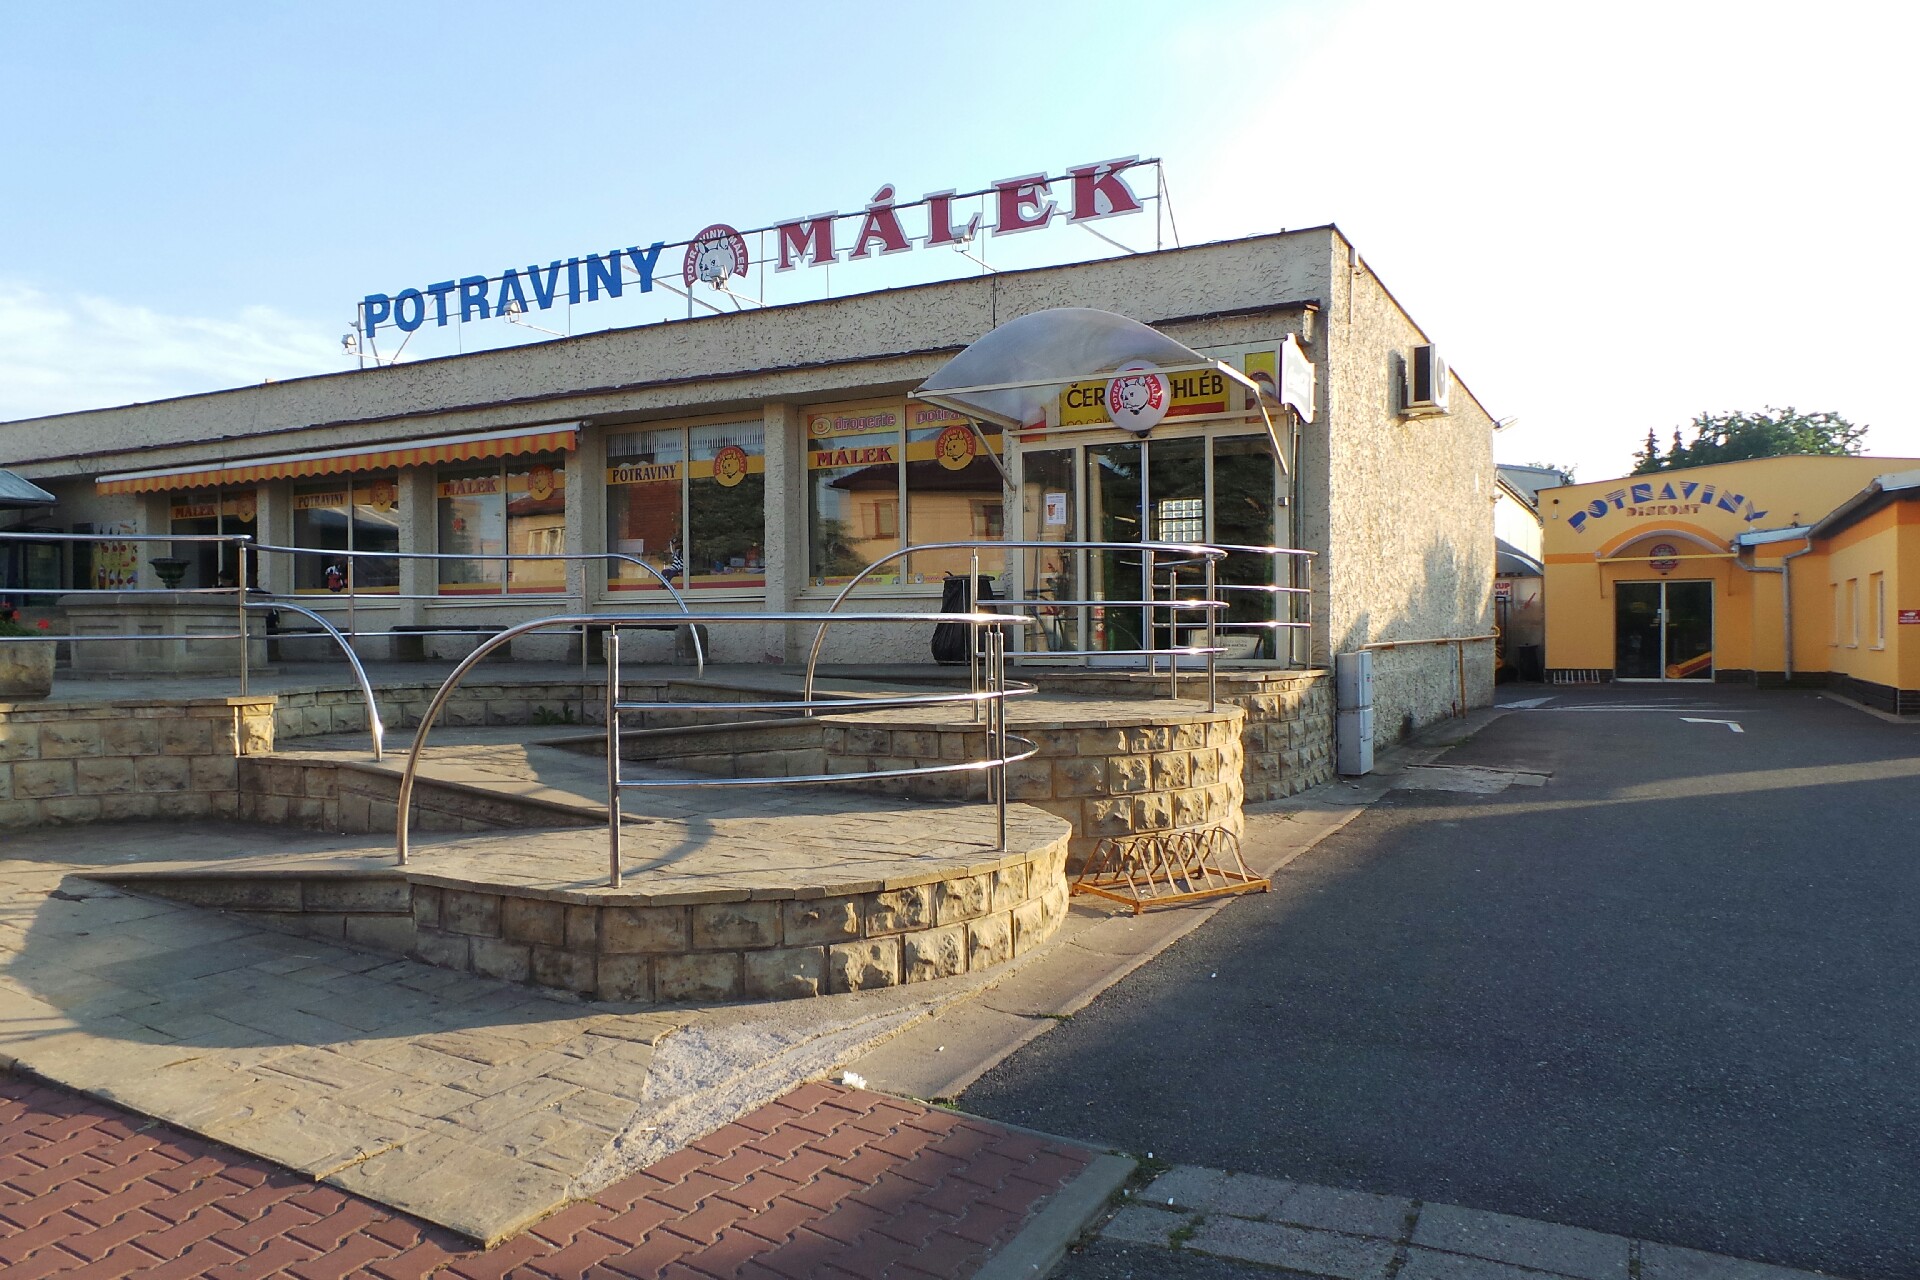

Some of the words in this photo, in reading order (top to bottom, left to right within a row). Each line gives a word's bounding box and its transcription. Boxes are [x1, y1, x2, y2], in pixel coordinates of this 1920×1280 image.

[775, 154, 1143, 273] MÁLEK
[364, 241, 665, 338] POTRAVINY
[1169, 370, 1224, 399] HLÉB
[834, 412, 896, 431] drogerie
[816, 446, 893, 467] MÁLEK
[612, 465, 677, 483] POTRAVINY
[299, 493, 344, 508] POTRAVINY
[1567, 481, 1769, 534] POTRAVINY
